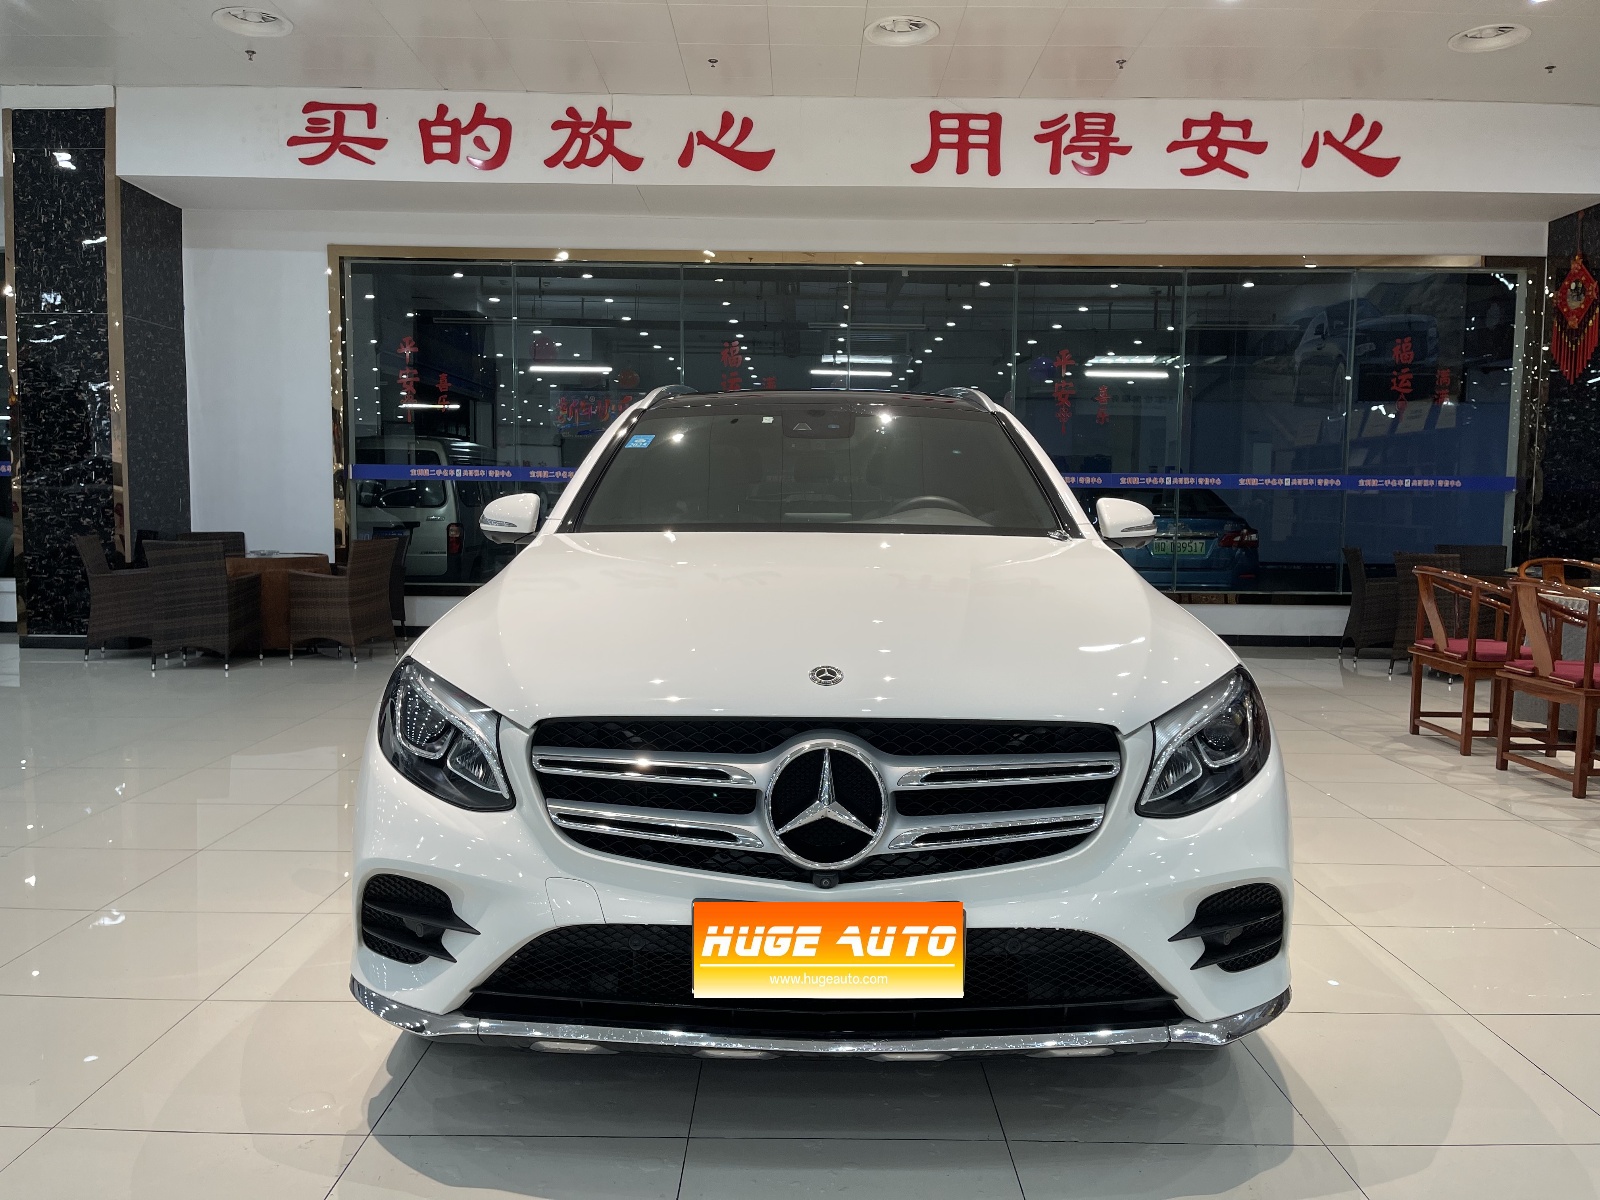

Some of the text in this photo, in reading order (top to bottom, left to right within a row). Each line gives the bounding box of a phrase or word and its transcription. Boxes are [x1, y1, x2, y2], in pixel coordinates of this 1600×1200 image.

[286, 101, 1402, 178] 买的放心 用得安心
[397, 335, 419, 394] 平安
[1052, 349, 1077, 408] 平安
[1391, 336, 1415, 394] 福运
[1095, 385, 1112, 425] 喜乐
